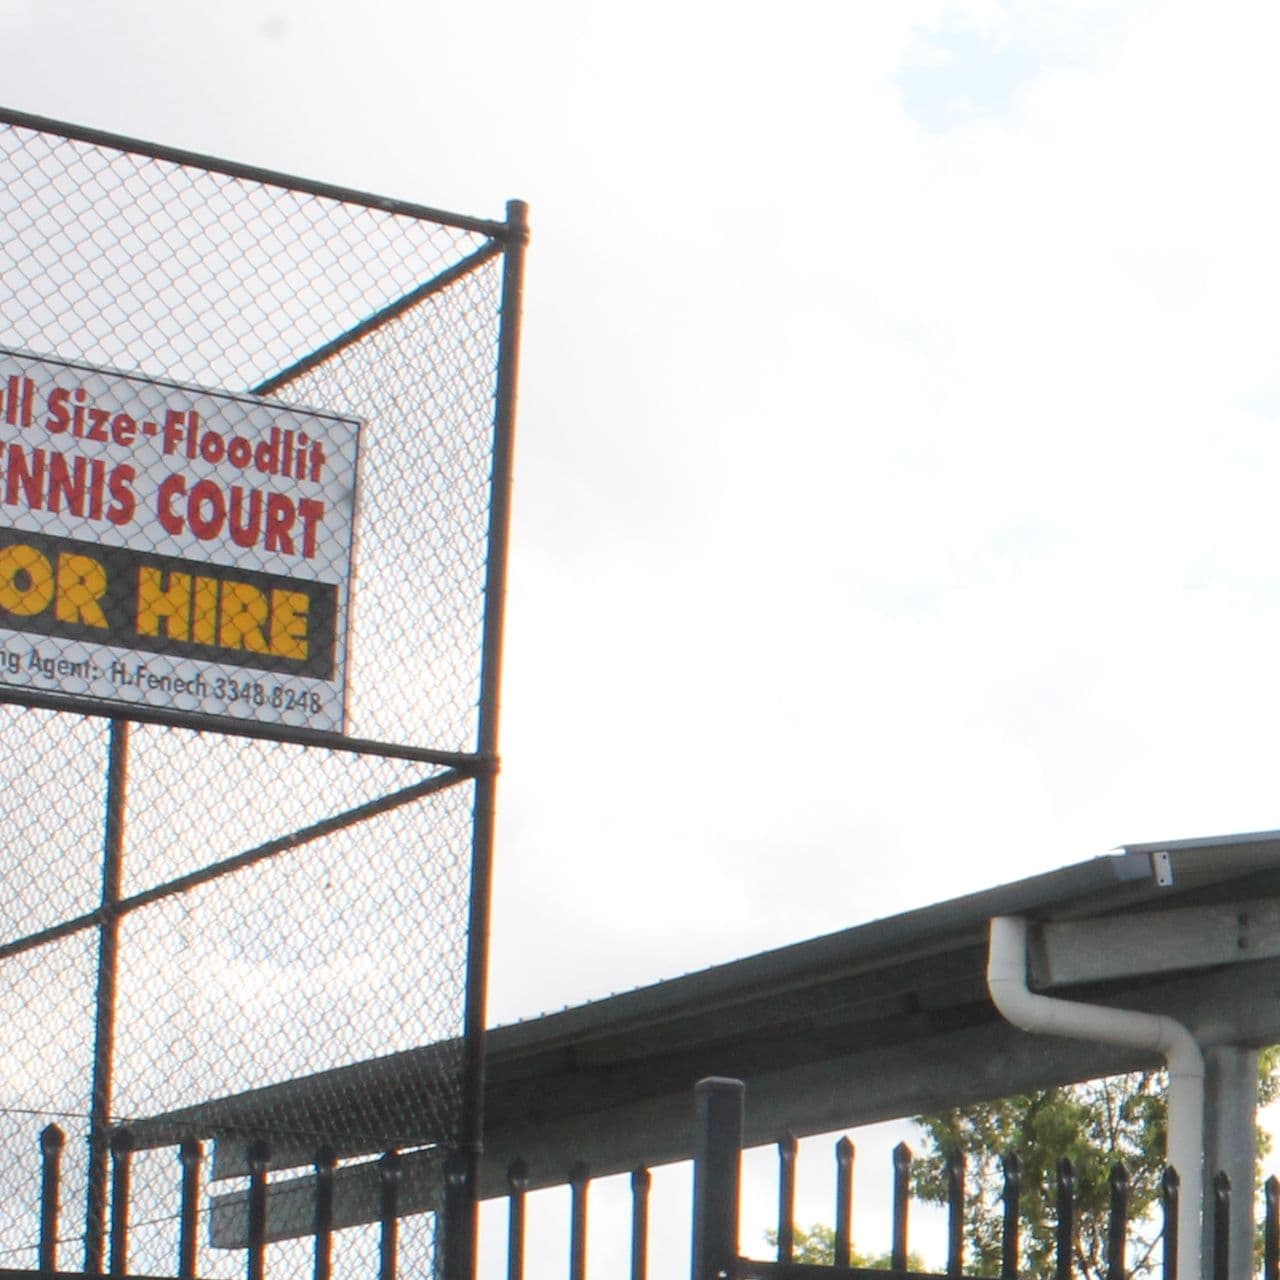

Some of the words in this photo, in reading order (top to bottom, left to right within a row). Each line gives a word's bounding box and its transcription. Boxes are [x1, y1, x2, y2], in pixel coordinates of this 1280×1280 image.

[0, 375, 34, 428] ll
[0, 440, 136, 526] NNIS
[158, 473, 325, 559] COURT
[136, 565, 310, 661] HIRE
[29, 648, 98, 681] Agent:
